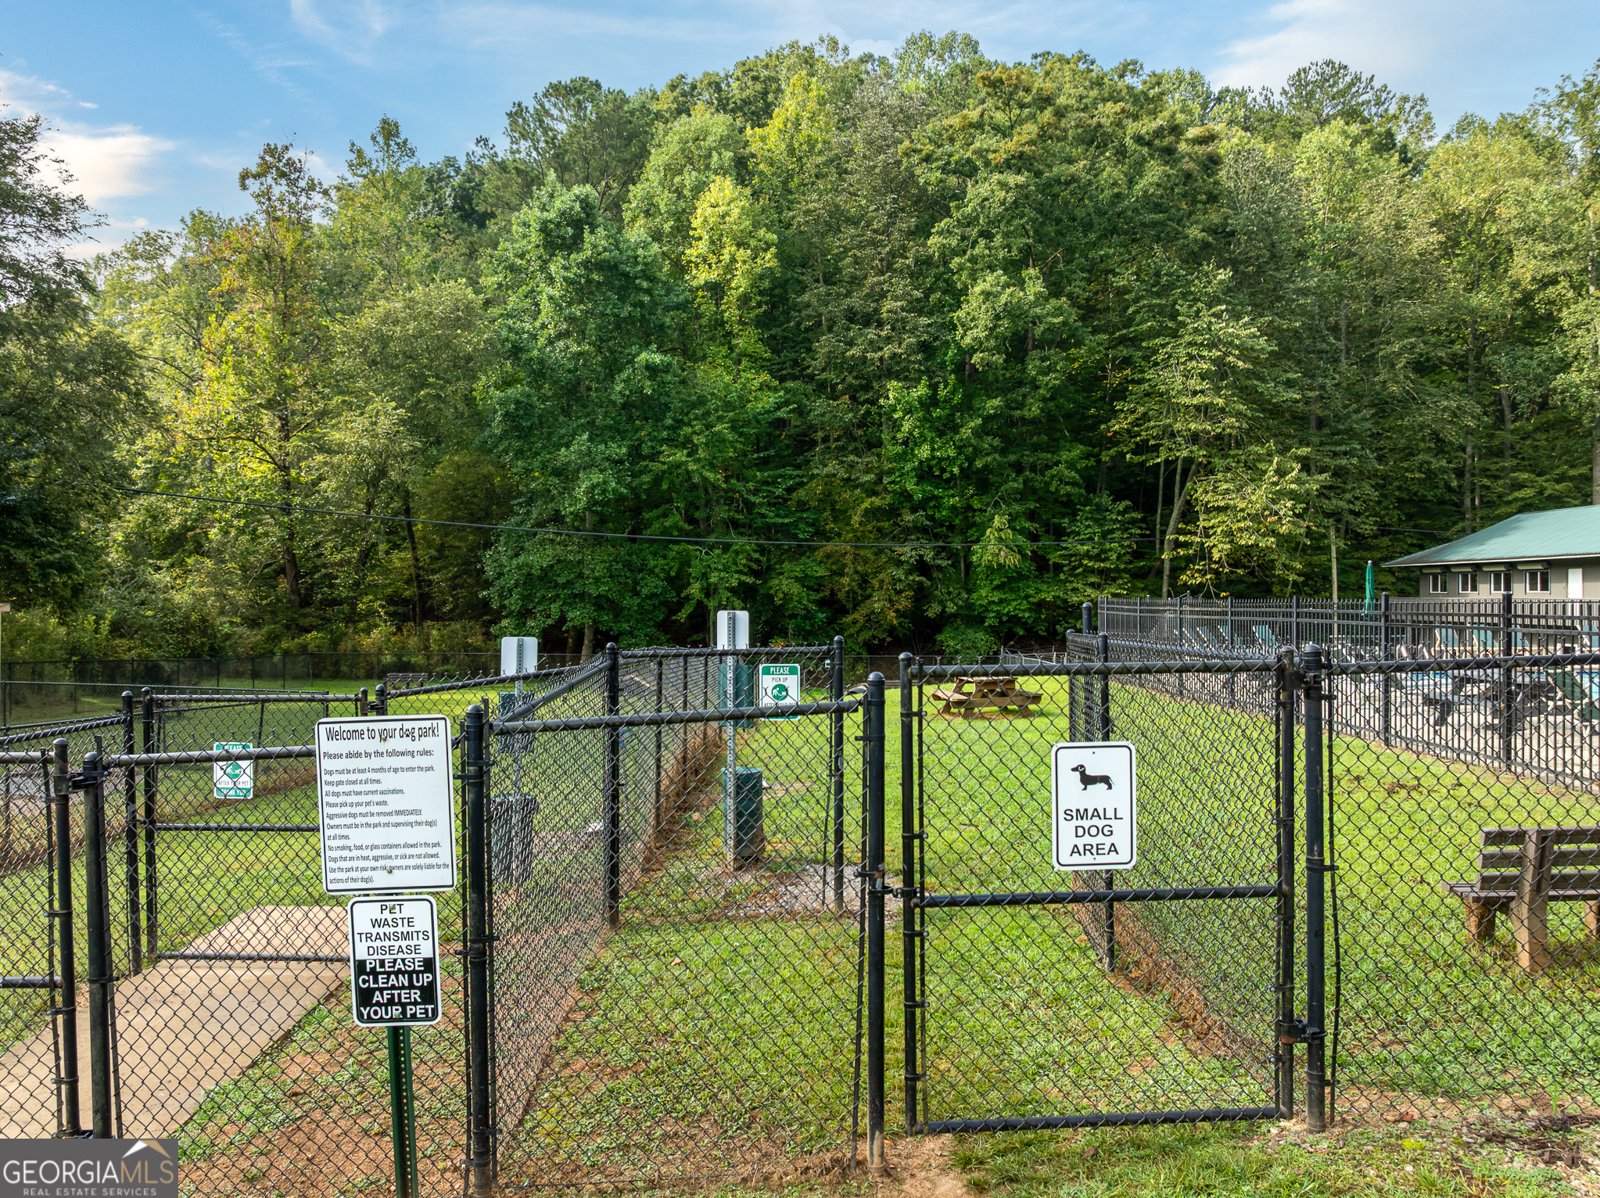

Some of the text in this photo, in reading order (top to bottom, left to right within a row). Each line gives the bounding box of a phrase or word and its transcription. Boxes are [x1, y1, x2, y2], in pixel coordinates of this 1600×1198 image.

[326, 726, 364, 741] Welcome
[367, 726, 376, 738] to
[378, 728, 397, 742] your
[418, 722, 439, 740] park!
[345, 750, 362, 758] abide
[364, 750, 371, 759] by
[374, 749, 384, 758] the
[386, 748, 415, 758] following
[416, 748, 434, 756] rules:
[425, 765, 435, 773] park.
[332, 790, 341, 798] dogs
[379, 788, 405, 796] vaccinations.
[326, 800, 338, 808] Please
[339, 800, 347, 808] pick
[365, 800, 375, 808] pet's
[326, 812, 347, 820] Aggressive
[348, 811, 358, 819] dogs
[1063, 808, 1123, 821] SMALL
[326, 822, 342, 830] Owners
[354, 821, 359, 829] be
[373, 821, 381, 829] park
[391, 820, 414, 828] supervising
[414, 819, 424, 827] their
[425, 819, 437, 828] dog(s)
[1075, 824, 1113, 838] DOG
[335, 844, 353, 852] smoking,
[354, 843, 364, 851] food,
[371, 843, 380, 851] glass
[431, 841, 442, 849] park.
[1070, 843, 1119, 857] AREA
[328, 855, 338, 863] Dogs
[361, 854, 371, 862] heat,
[372, 853, 394, 862] aggressive,
[345, 865, 353, 873] park
[412, 863, 423, 871] solely
[380, 904, 404, 914] PET
[370, 917, 415, 928] WASTE
[357, 930, 430, 942] TRANSMITS
[368, 944, 421, 956] DISEASE
[366, 958, 424, 972] PLEASE
[359, 973, 433, 988] CLEAN UP
[372, 990, 421, 1003] AFTER
[360, 1005, 434, 1019] YOUR PET
